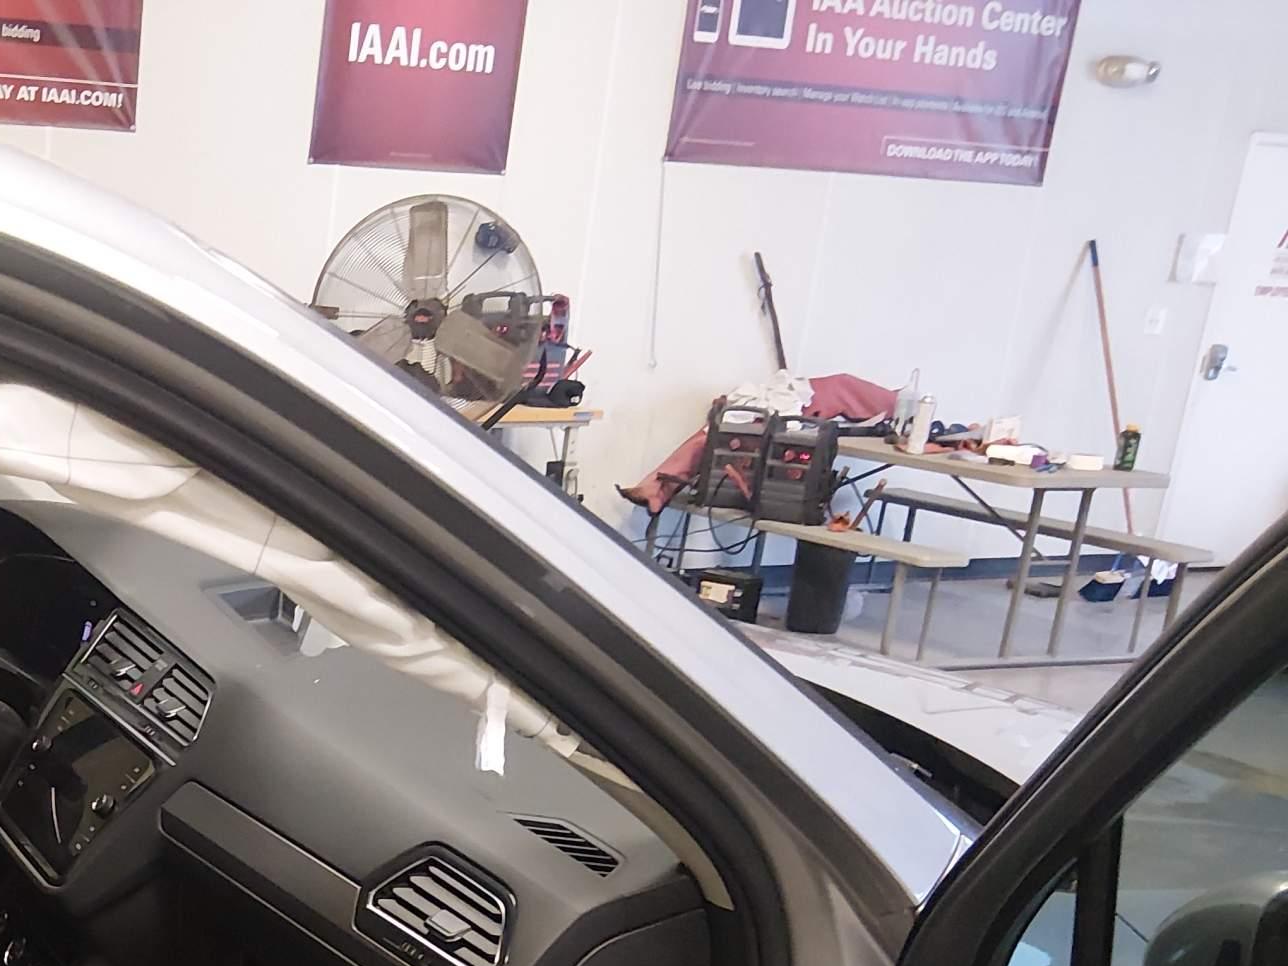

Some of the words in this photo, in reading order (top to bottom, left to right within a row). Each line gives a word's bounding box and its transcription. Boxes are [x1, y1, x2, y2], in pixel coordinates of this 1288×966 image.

[1, 23, 40, 42] bidding
[870, 0, 973, 27] Auction
[981, 5, 1067, 37] Center
[348, 21, 495, 74] IAAI.com
[805, 23, 832, 54] In
[844, 26, 907, 61] Your
[912, 40, 997, 71] Hands
[16, 84, 39, 101] AT
[41, 86, 124, 108] IAAI.COM!
[886, 144, 952, 161] DOWNLOAD
[952, 149, 973, 163] THE
[974, 151, 999, 164] APP
